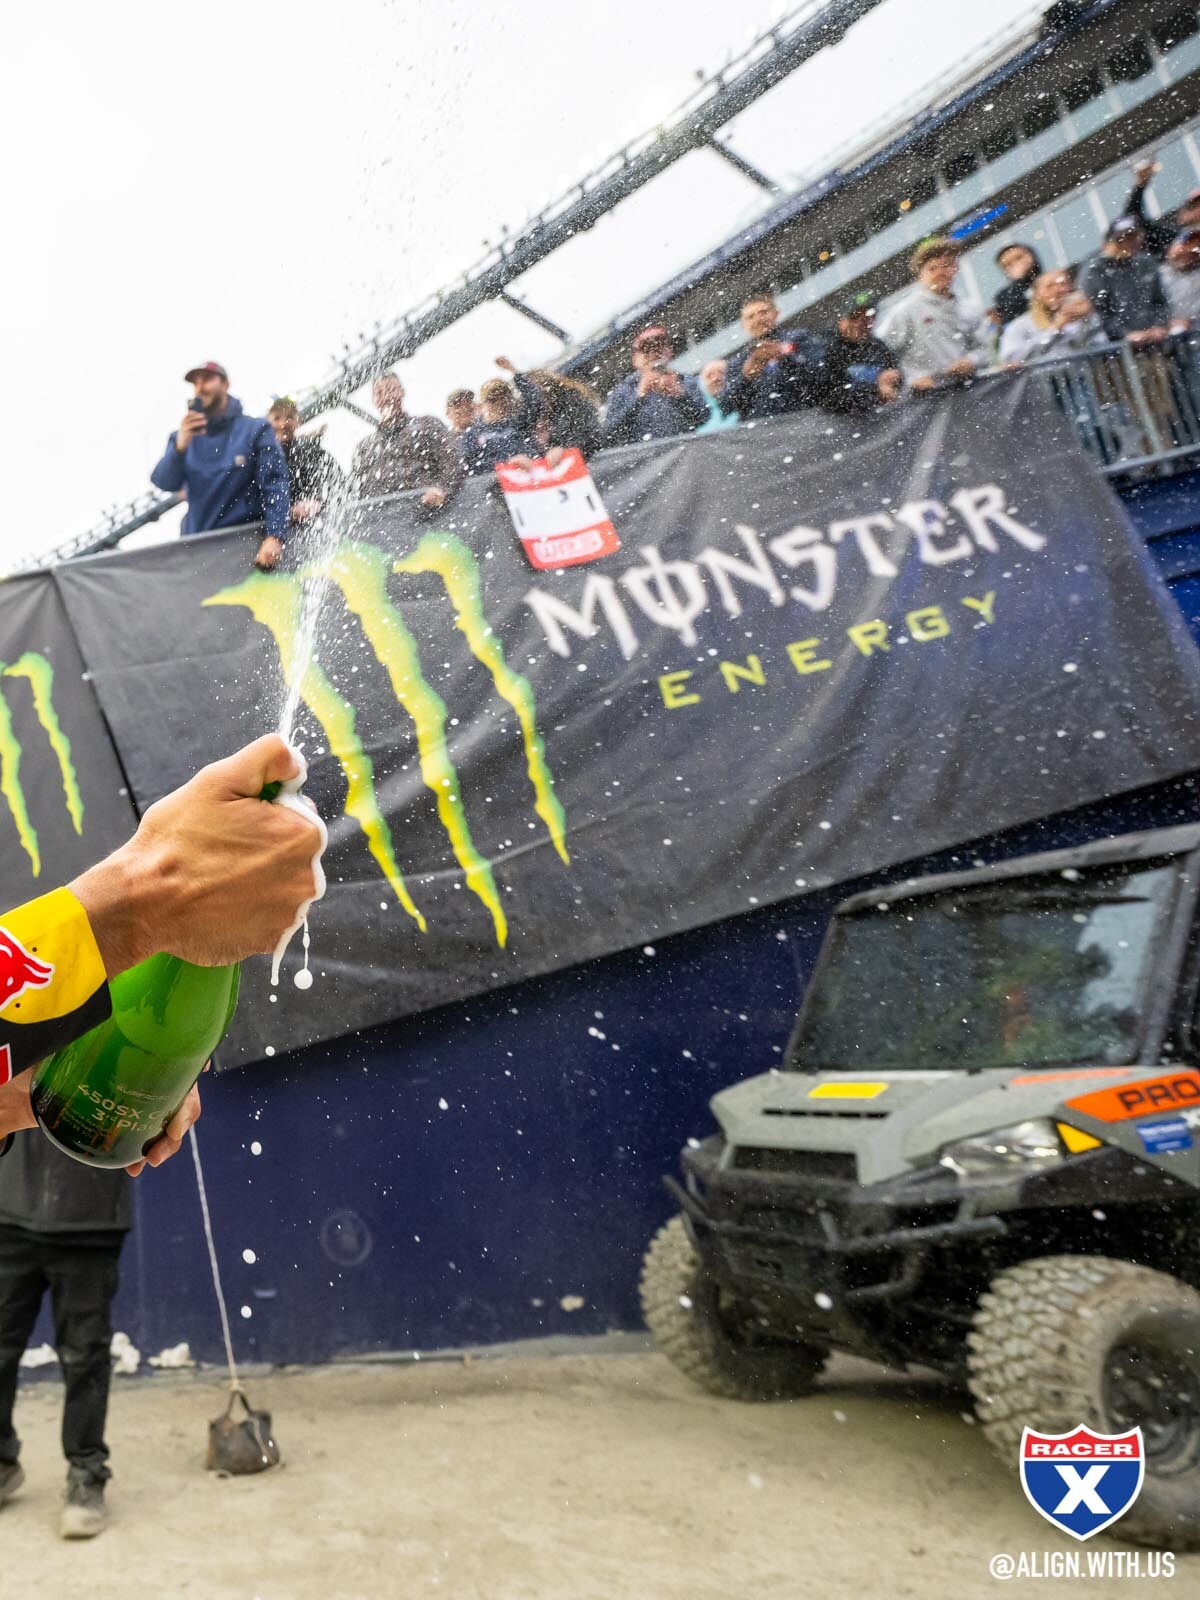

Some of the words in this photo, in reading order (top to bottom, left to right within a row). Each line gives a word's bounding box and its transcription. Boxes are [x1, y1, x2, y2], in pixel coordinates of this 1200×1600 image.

[523, 484, 1047, 660] MONSTER
[658, 590, 997, 710] ENERGY
[78, 1083, 145, 1120] 450SX
